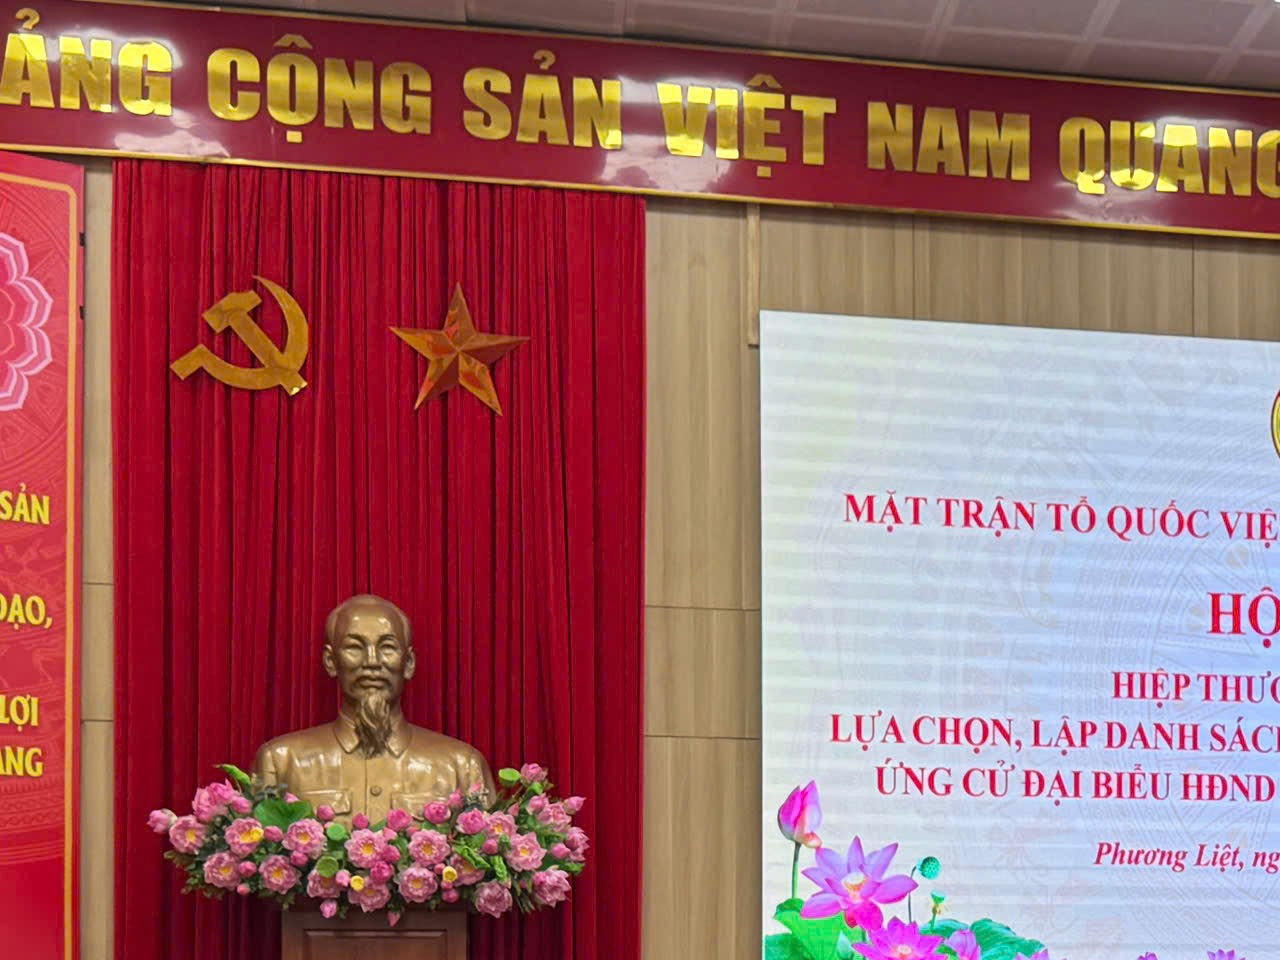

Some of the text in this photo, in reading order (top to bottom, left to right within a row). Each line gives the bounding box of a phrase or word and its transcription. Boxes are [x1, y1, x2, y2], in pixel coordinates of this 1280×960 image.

[0, 8, 173, 117] ẢNG
[206, 32, 432, 144] CỘNG
[462, 49, 623, 150] SẢN
[656, 72, 837, 177] VIỆT
[866, 100, 1031, 181] NAM
[0, 483, 50, 525] SẢN
[843, 490, 928, 532] MẶT
[937, 495, 1036, 537] TRẬN
[1046, 495, 1096, 533] TỔ
[1107, 499, 1209, 541] QUỐC
[1111, 667, 1191, 709] HIỆP
[0, 694, 39, 732] LỢI
[830, 708, 904, 751] LỰA
[912, 715, 1022, 755] CHỌN,
[1030, 715, 1097, 756] LẬP
[1104, 721, 1200, 750] DANH
[875, 758, 952, 797] ỨNG
[962, 759, 1015, 798] CỬ
[1022, 770, 1083, 806] ĐẠI
[1091, 763, 1171, 801] BIỂU
[1180, 773, 1275, 803] HĐND
[1094, 841, 1188, 872] Phương
[1194, 842, 1245, 872] Liệt,
